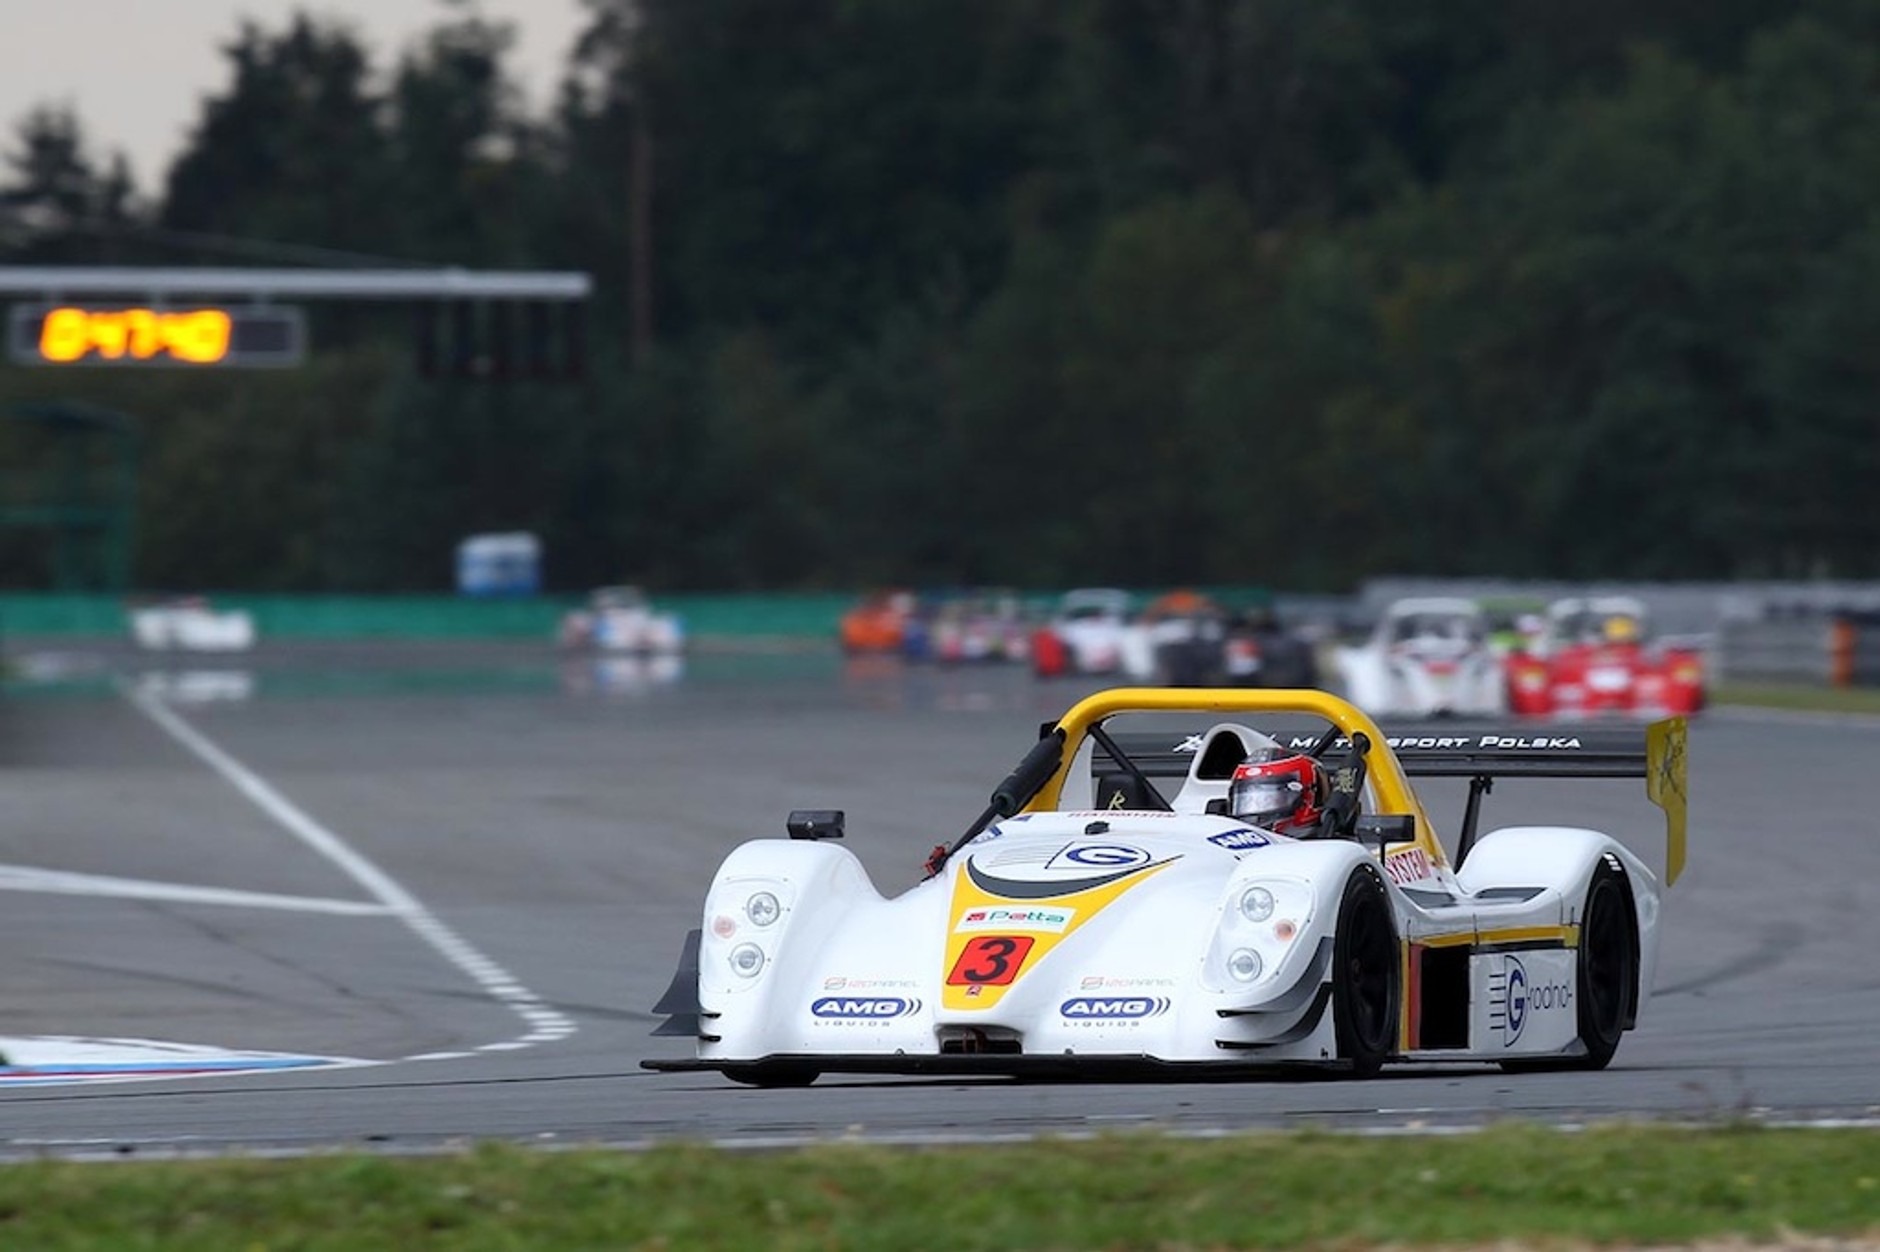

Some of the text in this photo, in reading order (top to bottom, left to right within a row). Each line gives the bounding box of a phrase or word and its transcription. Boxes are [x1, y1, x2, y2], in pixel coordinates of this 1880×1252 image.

[1289, 736, 1469, 749] MTSPORT
[963, 937, 1017, 982] 3
[816, 1000, 899, 1015] AMG
[1065, 1000, 1148, 1015] AMG
